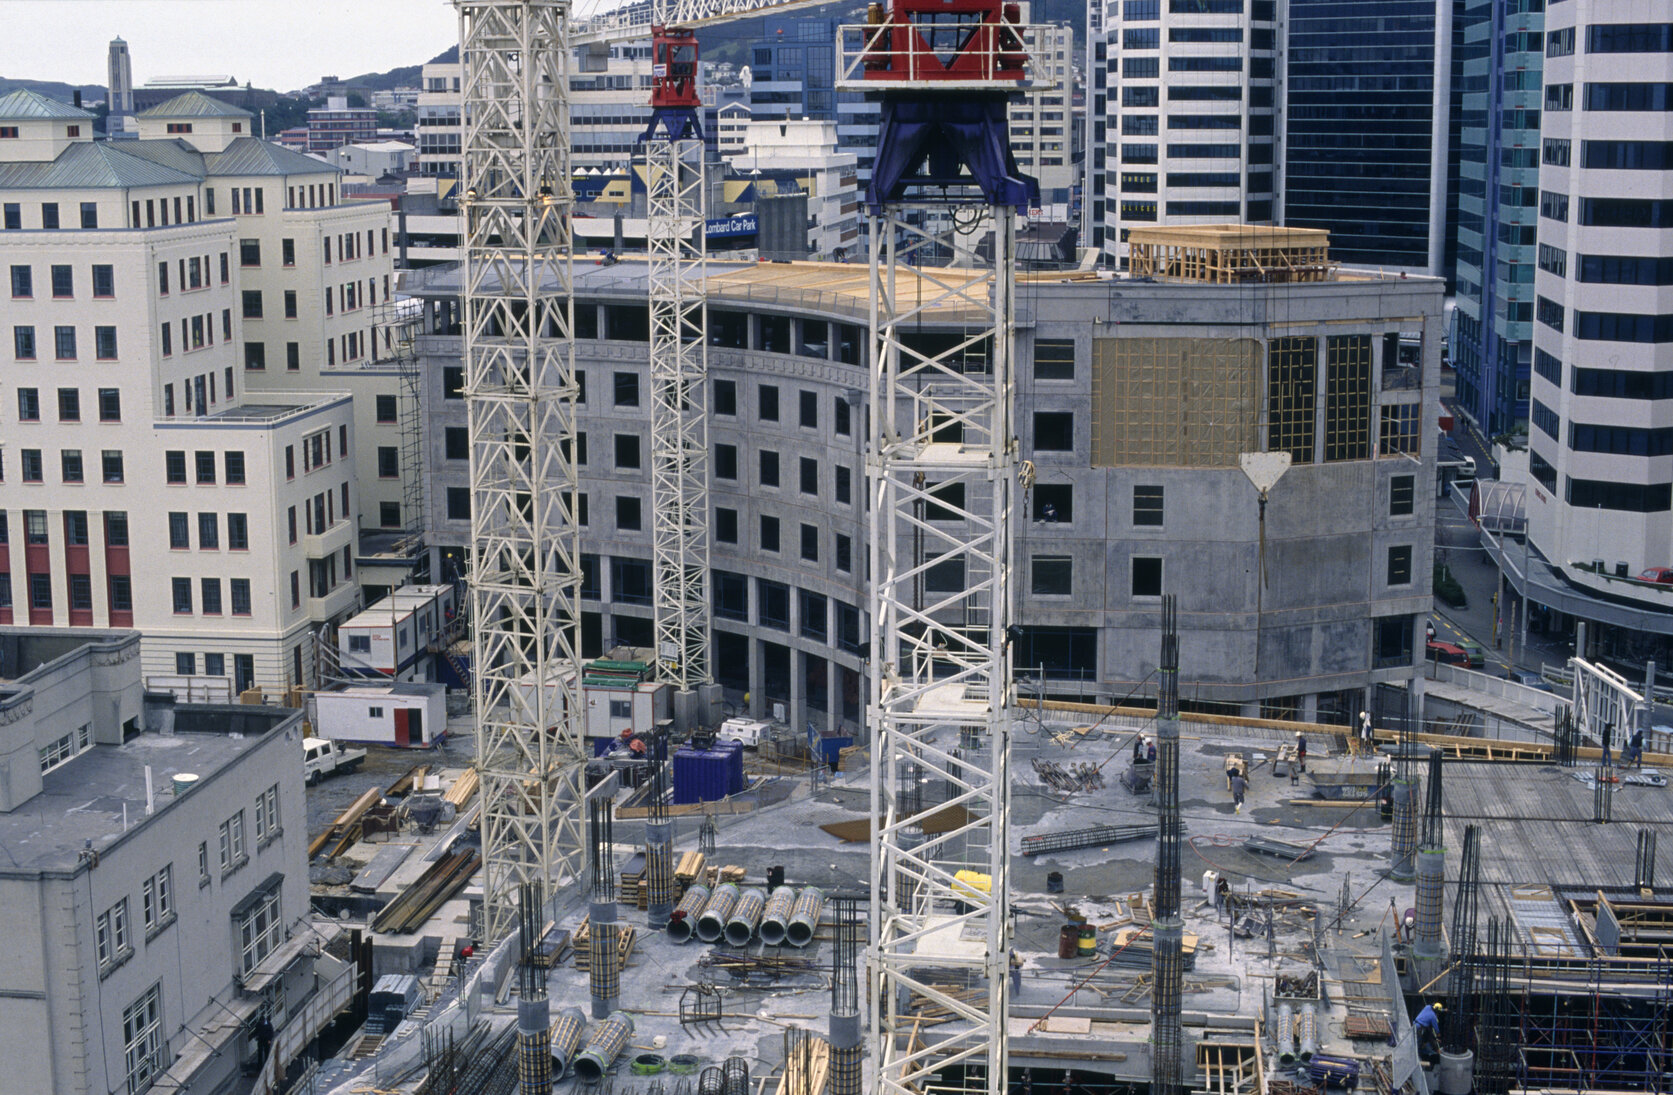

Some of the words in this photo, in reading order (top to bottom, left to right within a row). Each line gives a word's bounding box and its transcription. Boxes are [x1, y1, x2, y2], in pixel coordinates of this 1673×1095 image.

[705, 221, 730, 234] Lombard
[731, 220, 742, 232] Car
[743, 219, 756, 230] Park
